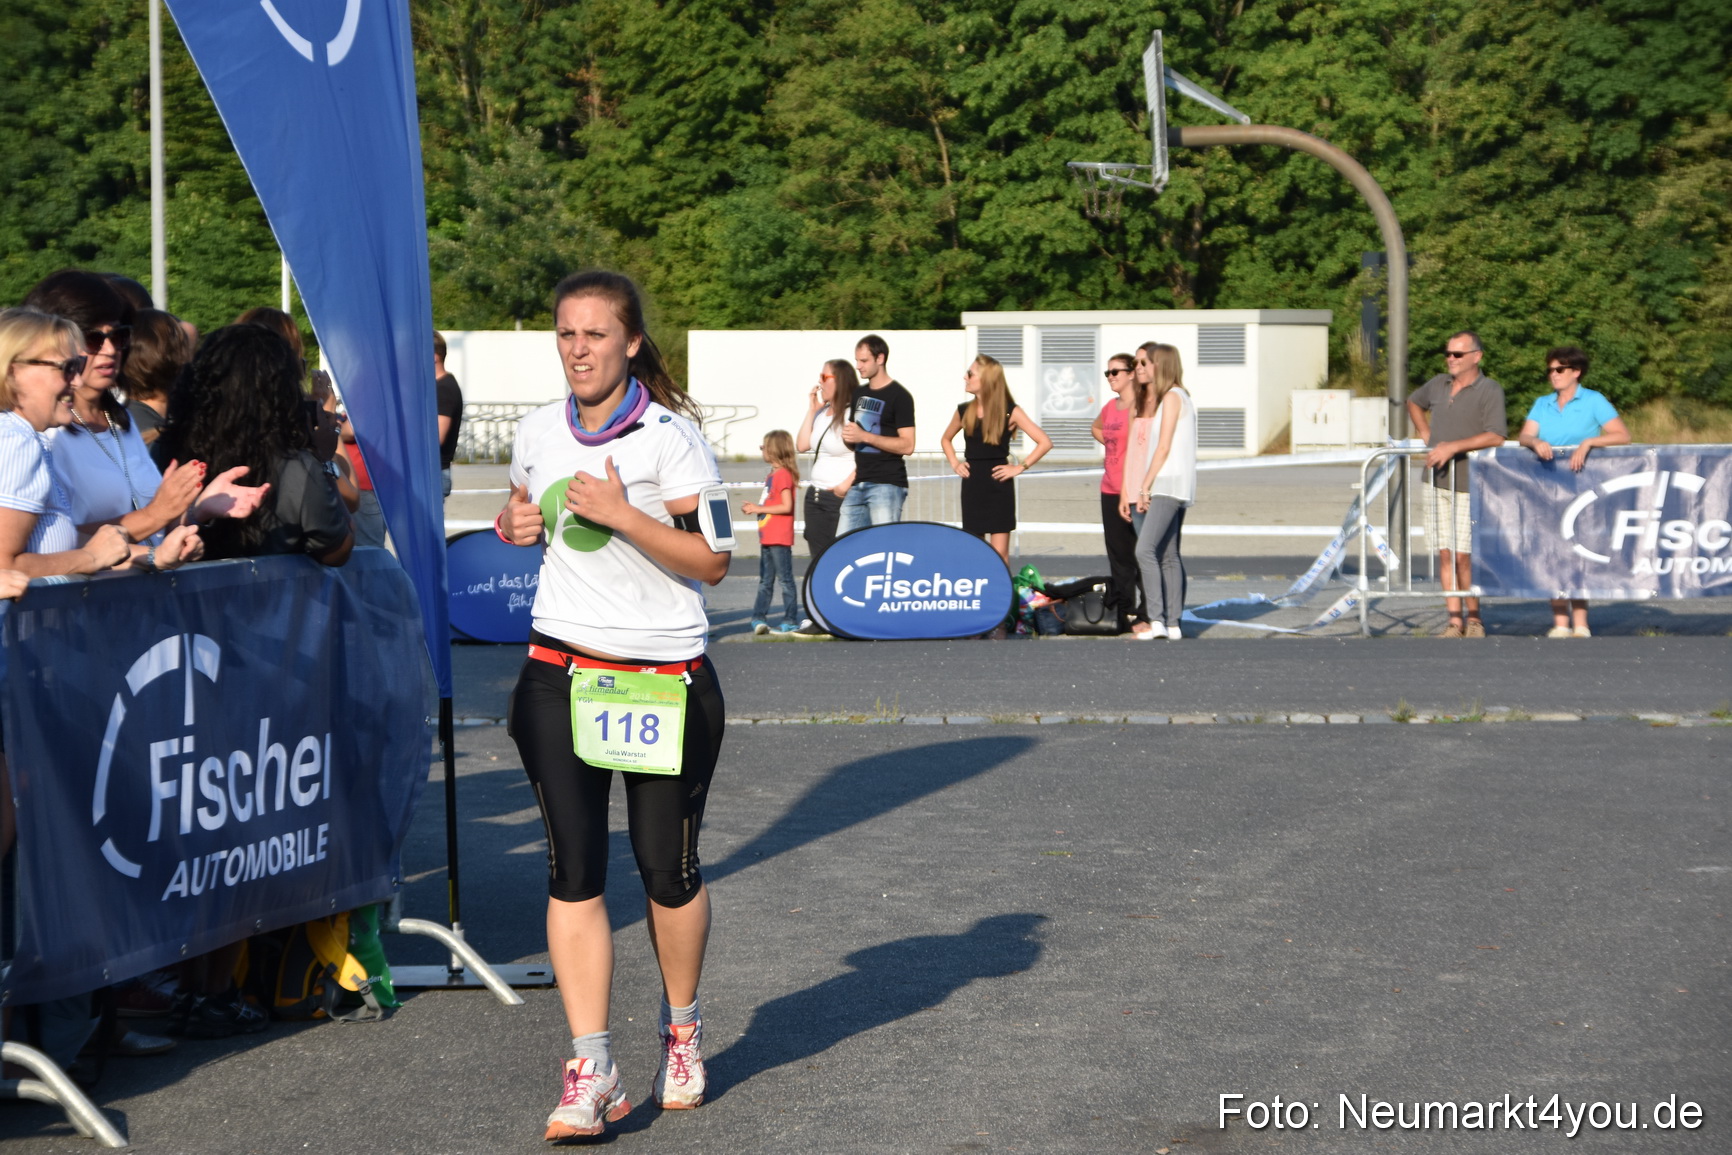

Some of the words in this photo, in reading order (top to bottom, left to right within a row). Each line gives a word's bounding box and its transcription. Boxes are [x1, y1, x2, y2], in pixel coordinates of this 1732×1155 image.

[856, 398, 882, 412] PUMA
[467, 576, 494, 593] und
[498, 573, 522, 588] das
[864, 572, 989, 600] Fischer
[878, 599, 981, 613] AUTOMOBILE
[595, 710, 659, 745] 118
[620, 750, 646, 758] Warstat
[161, 822, 330, 901] AUTOMOBILE
